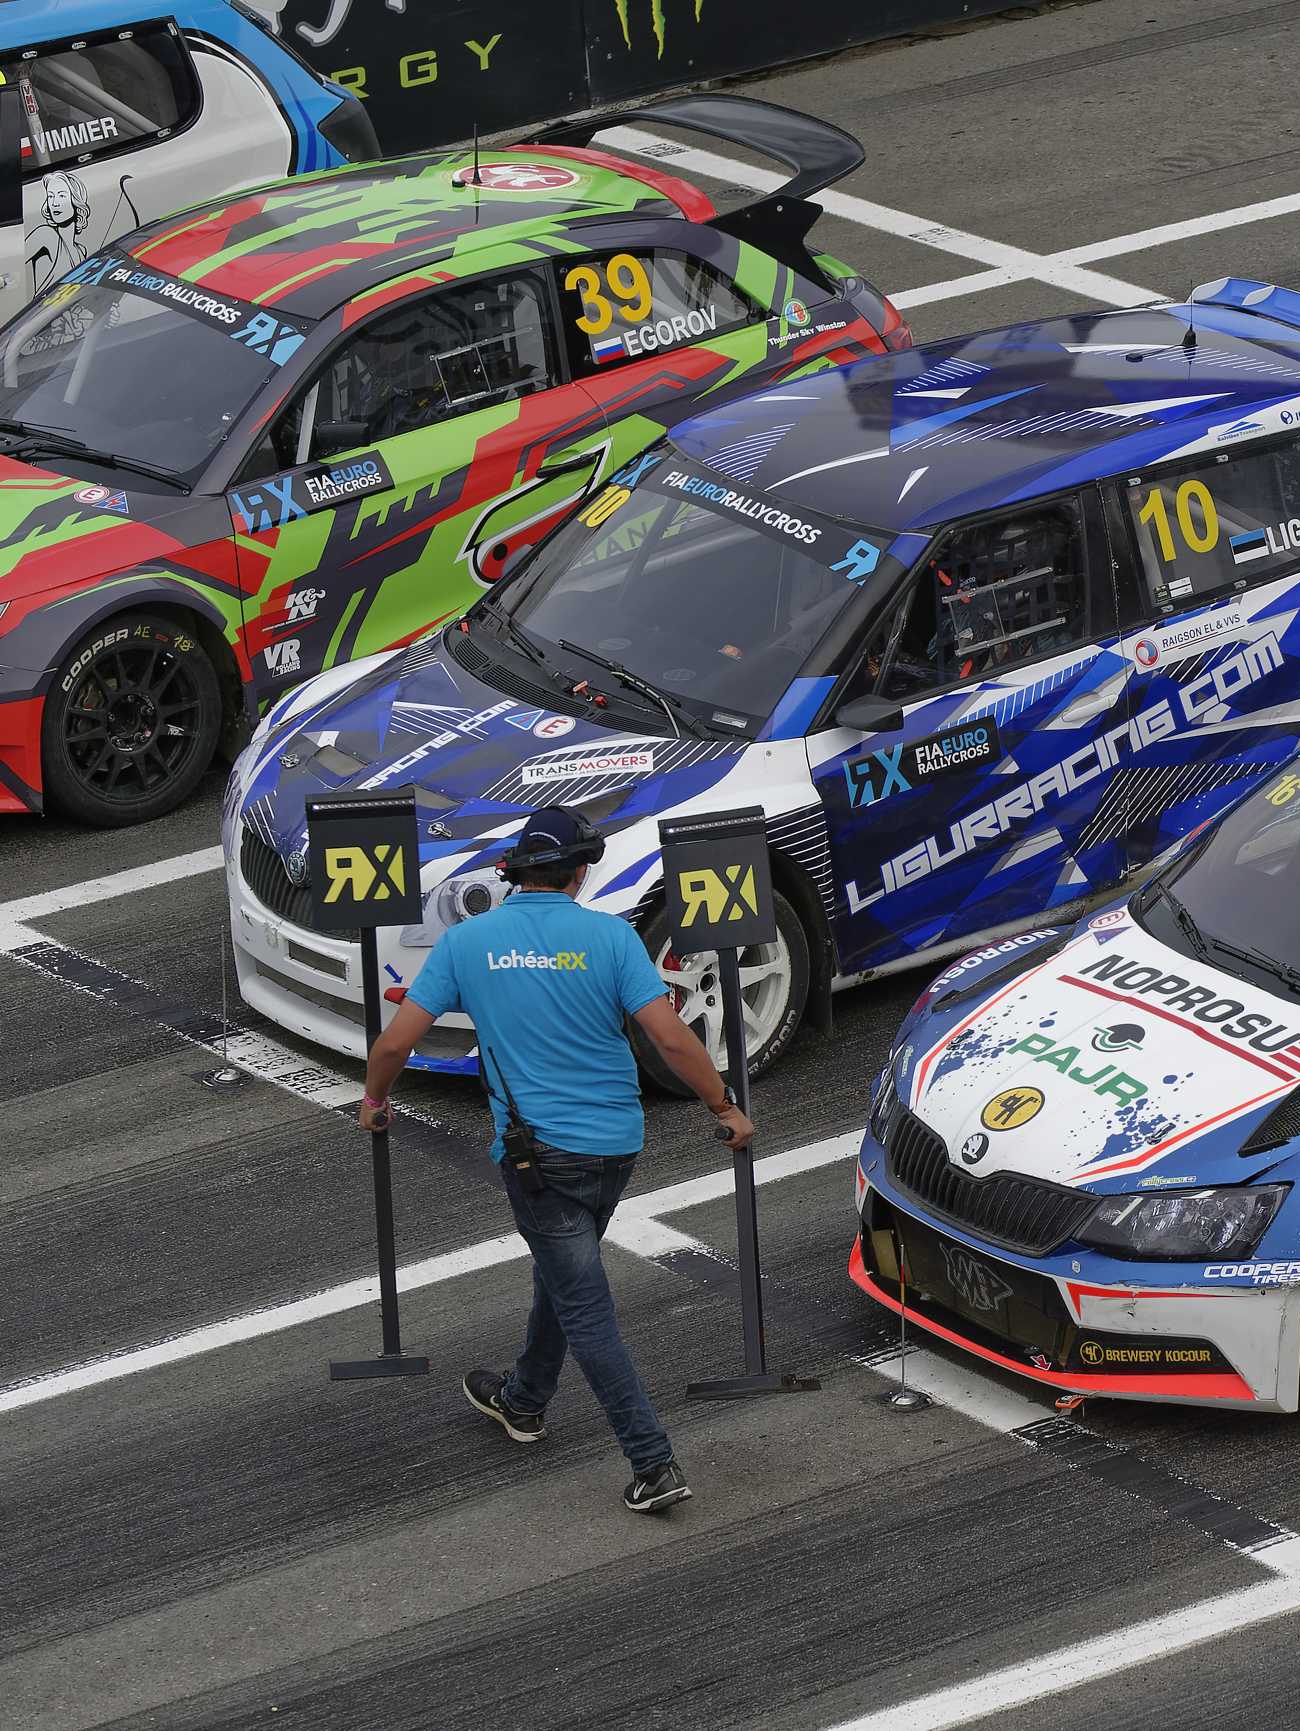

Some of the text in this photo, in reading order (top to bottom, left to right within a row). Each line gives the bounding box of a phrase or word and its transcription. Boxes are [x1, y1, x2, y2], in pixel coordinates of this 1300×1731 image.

[35, 117, 119, 154] VIMMER
[127, 272, 167, 291] EURO
[160, 283, 242, 325] RALLYCROSS
[564, 253, 653, 335] 39
[624, 305, 717, 357] EGOROV
[768, 319, 847, 347] Thunder Sky Winston
[311, 473, 382, 504] RALLYCROSS
[577, 484, 631, 528] 10
[1138, 478, 1220, 563] 10
[1162, 613, 1241, 648] RAIGSON EL & VVS
[62, 628, 129, 692] COOPER
[263, 639, 301, 670] VR
[527, 755, 648, 778] TRANSMOVERS
[917, 743, 990, 775] RALLYCROSS
[928, 928, 1059, 993] NOPROSU
[1006, 1032, 1149, 1108] PAJR
[1106, 1350, 1211, 1363] BREWERY KOCOUR
